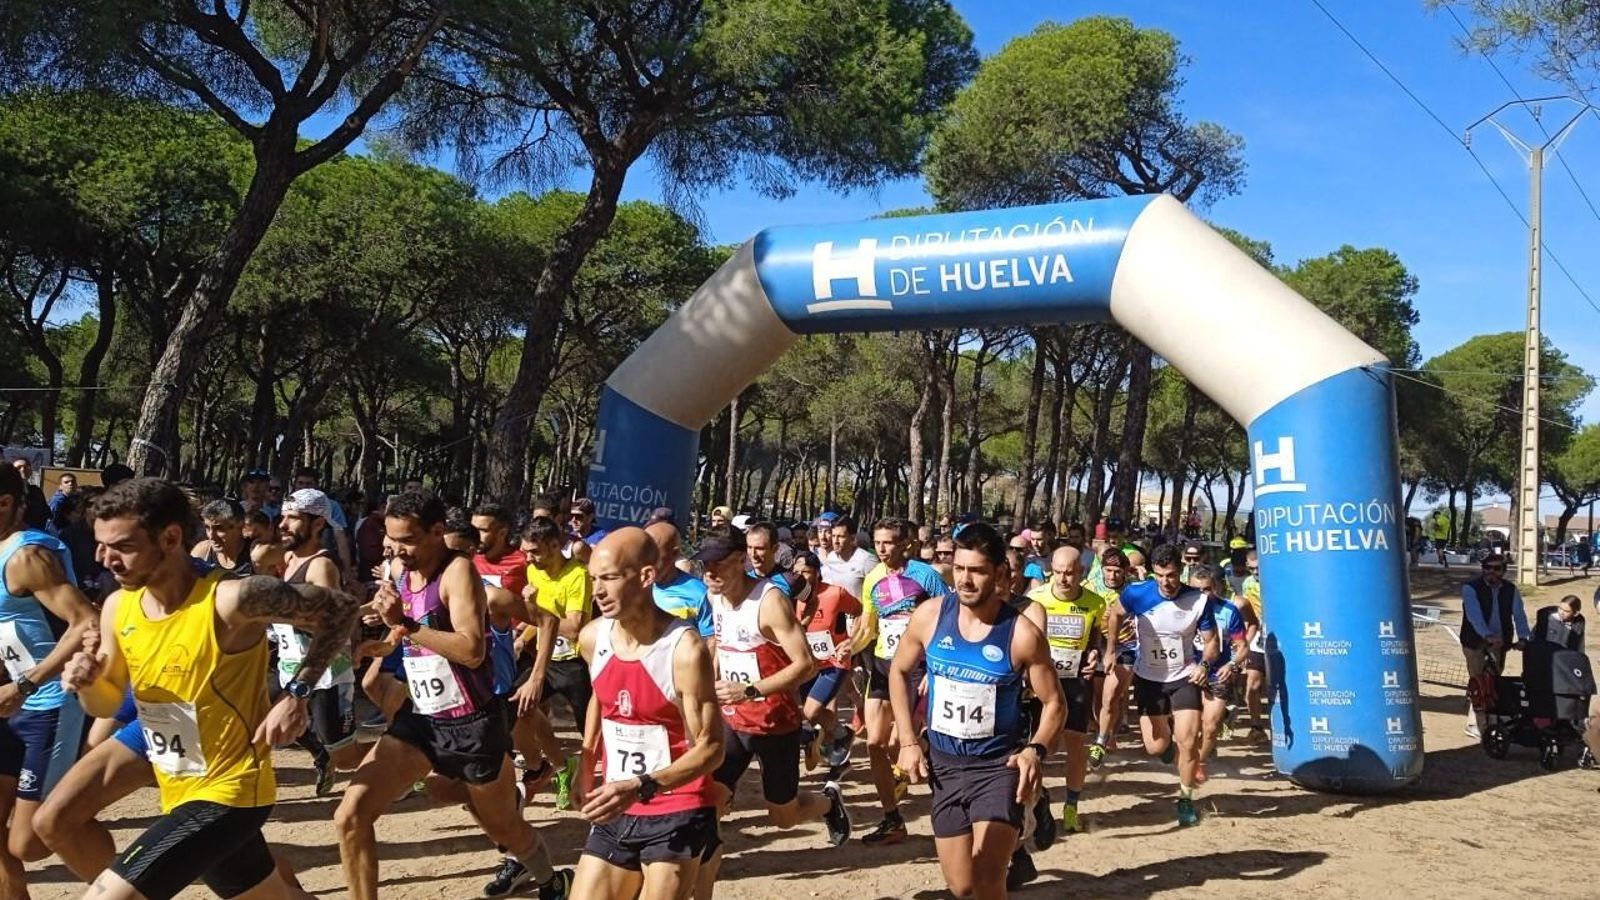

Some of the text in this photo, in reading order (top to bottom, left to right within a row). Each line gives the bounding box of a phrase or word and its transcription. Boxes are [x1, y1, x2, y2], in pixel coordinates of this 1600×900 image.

[889, 216, 1094, 260] DIPUTACIÓN
[889, 254, 1074, 296] DE HUELVA
[1258, 498, 1396, 530] DIPUTACIÓN
[1260, 529, 1389, 555] DE HUELVA
[1151, 649, 1178, 660] 156
[412, 678, 446, 700] 819
[943, 700, 984, 724] 514
[617, 749, 647, 776] 73
